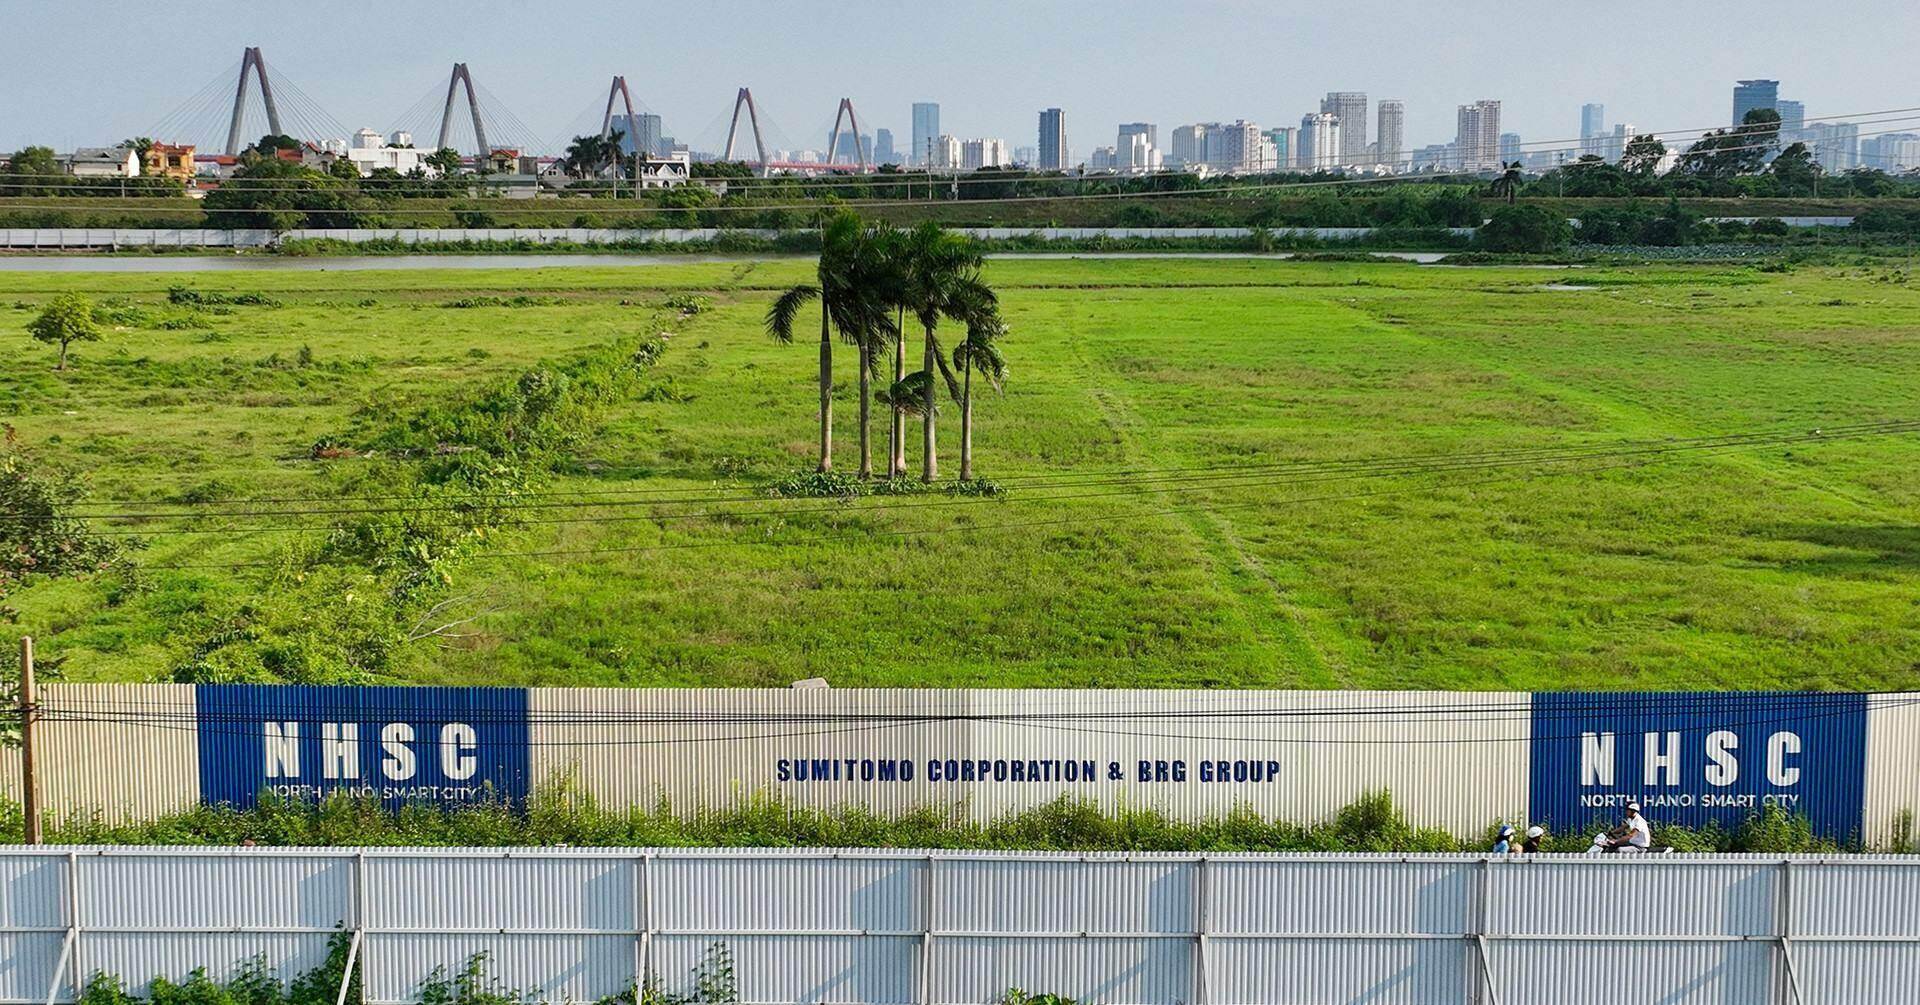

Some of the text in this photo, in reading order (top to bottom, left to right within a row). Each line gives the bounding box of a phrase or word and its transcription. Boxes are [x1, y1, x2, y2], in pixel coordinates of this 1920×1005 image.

[777, 759, 1280, 783] SUMITOMO CORPORATION & BRG GROUP
[326, 786, 379, 799] HNOI
[383, 786, 439, 799] SMART
[441, 787, 477, 800] CITY
[1643, 794, 1696, 807] HANOI
[1701, 794, 1756, 807] SMART
